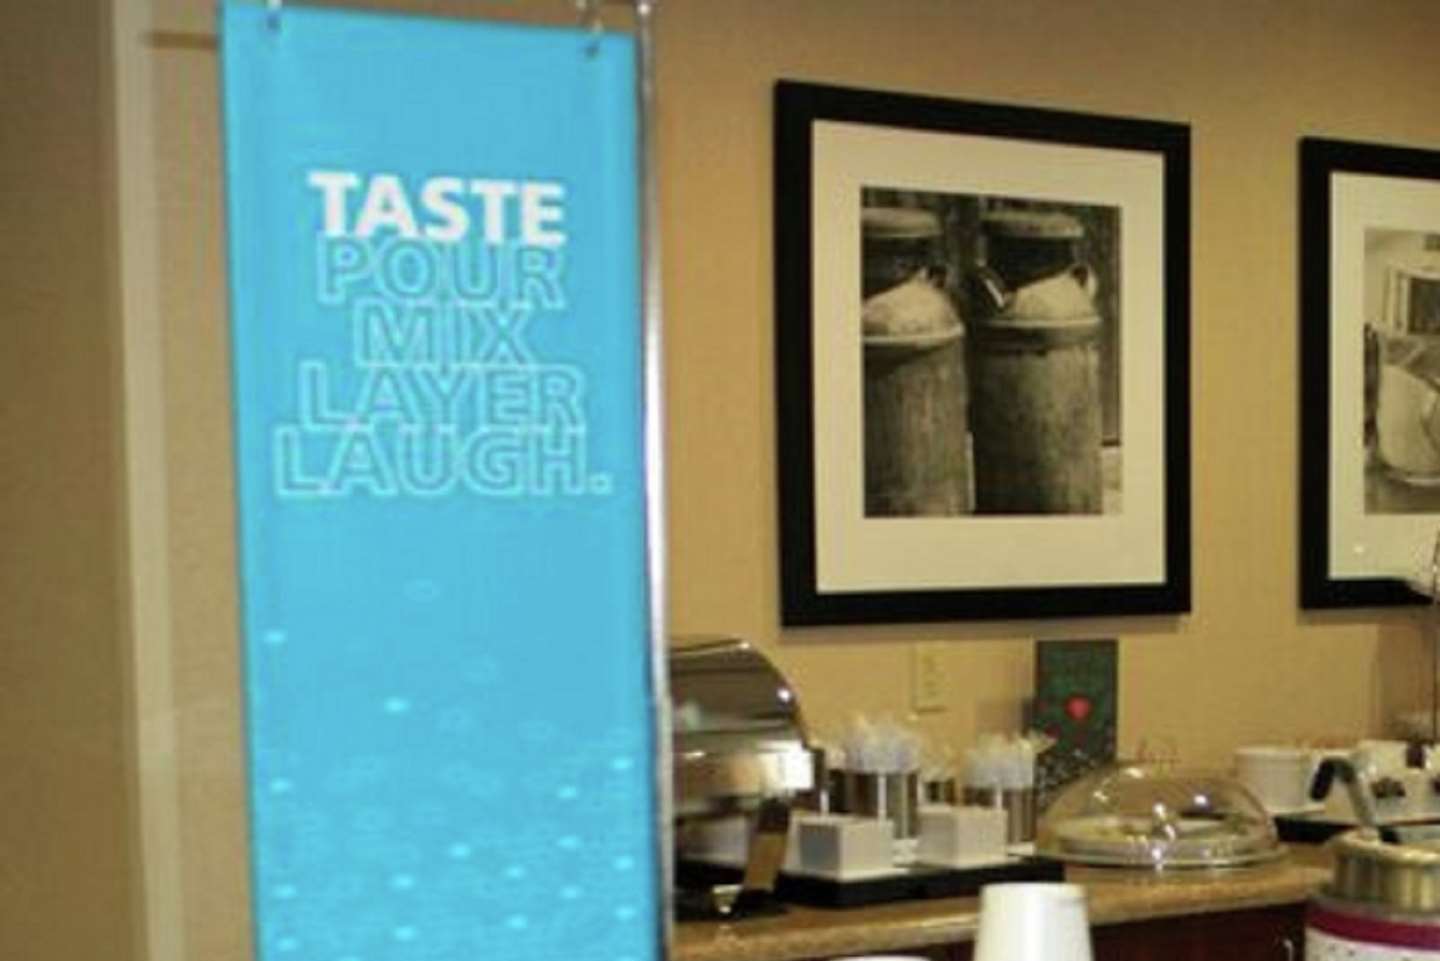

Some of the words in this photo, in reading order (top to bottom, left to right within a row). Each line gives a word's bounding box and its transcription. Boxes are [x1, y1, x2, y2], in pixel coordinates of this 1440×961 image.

[307, 170, 568, 247] TASTE
[317, 233, 566, 310] POUR
[354, 297, 536, 369] MIX
[299, 360, 586, 434] LAYER
[275, 424, 613, 497] LAUGH.
